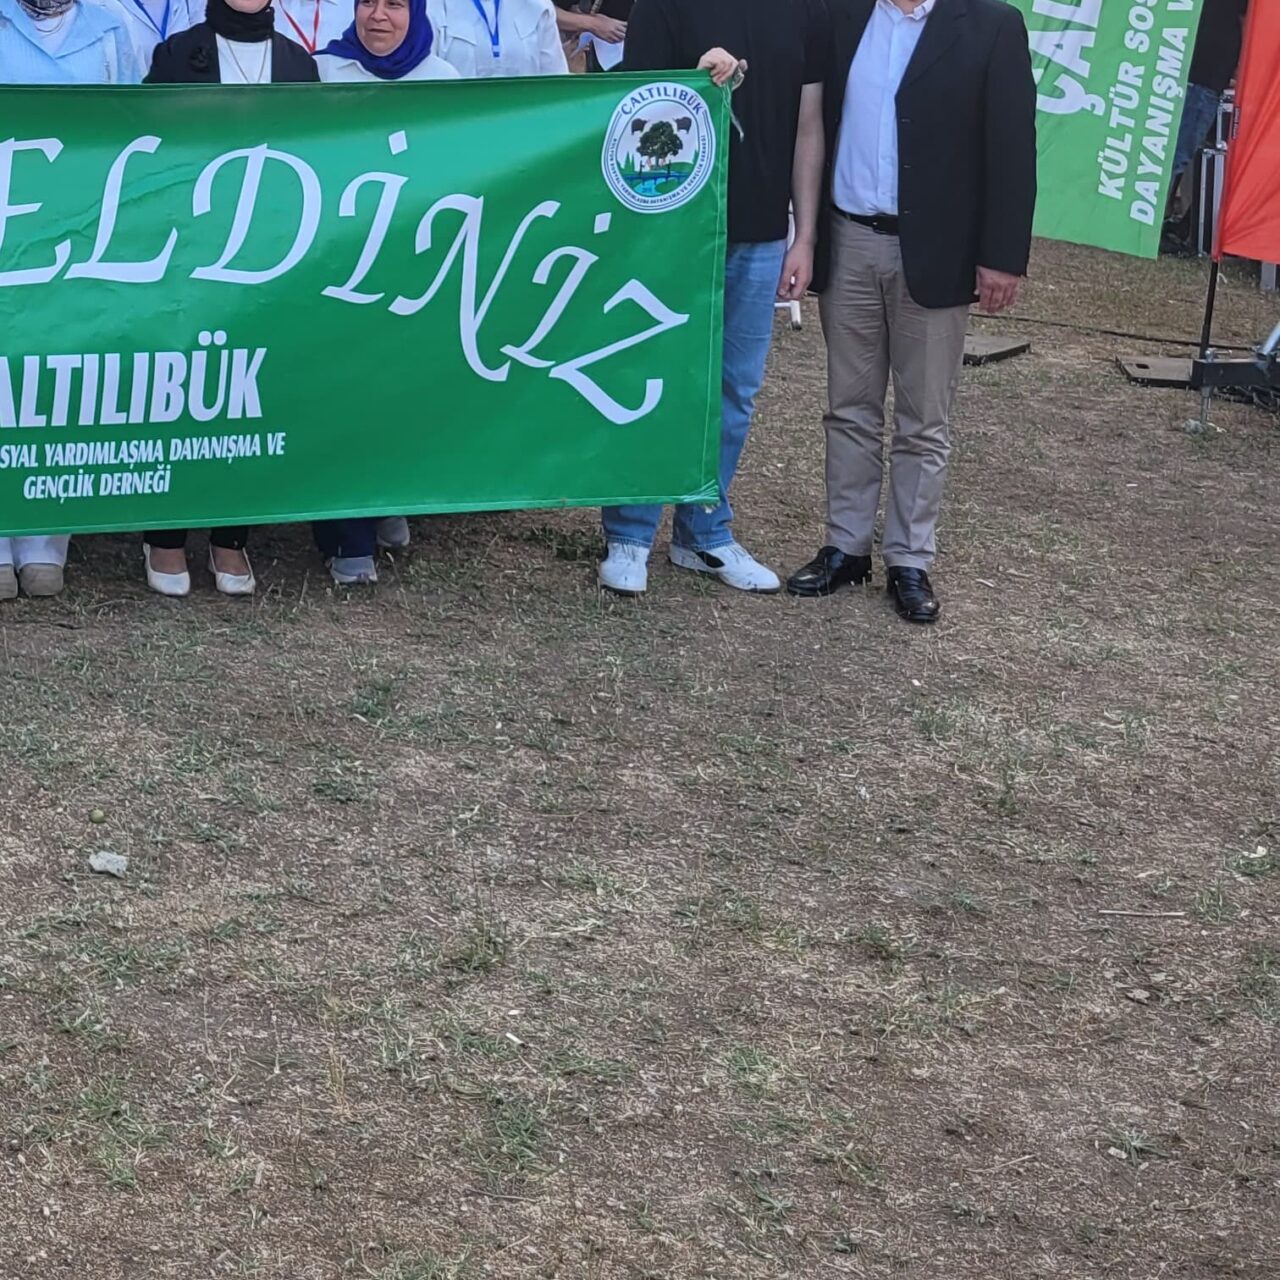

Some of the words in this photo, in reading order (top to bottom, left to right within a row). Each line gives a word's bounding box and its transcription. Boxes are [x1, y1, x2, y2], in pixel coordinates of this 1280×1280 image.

[1098, 61, 1145, 200] KÜLTÜR
[1130, 27, 1189, 226] DAYANIŞMA
[23, 469, 95, 503] GENÇLİK
[99, 464, 171, 495] DERNEĞİ
[45, 438, 164, 470] YARDIMLAŞMA
[170, 434, 261, 465] DAYANIŞMA
[267, 432, 287, 455] VE
